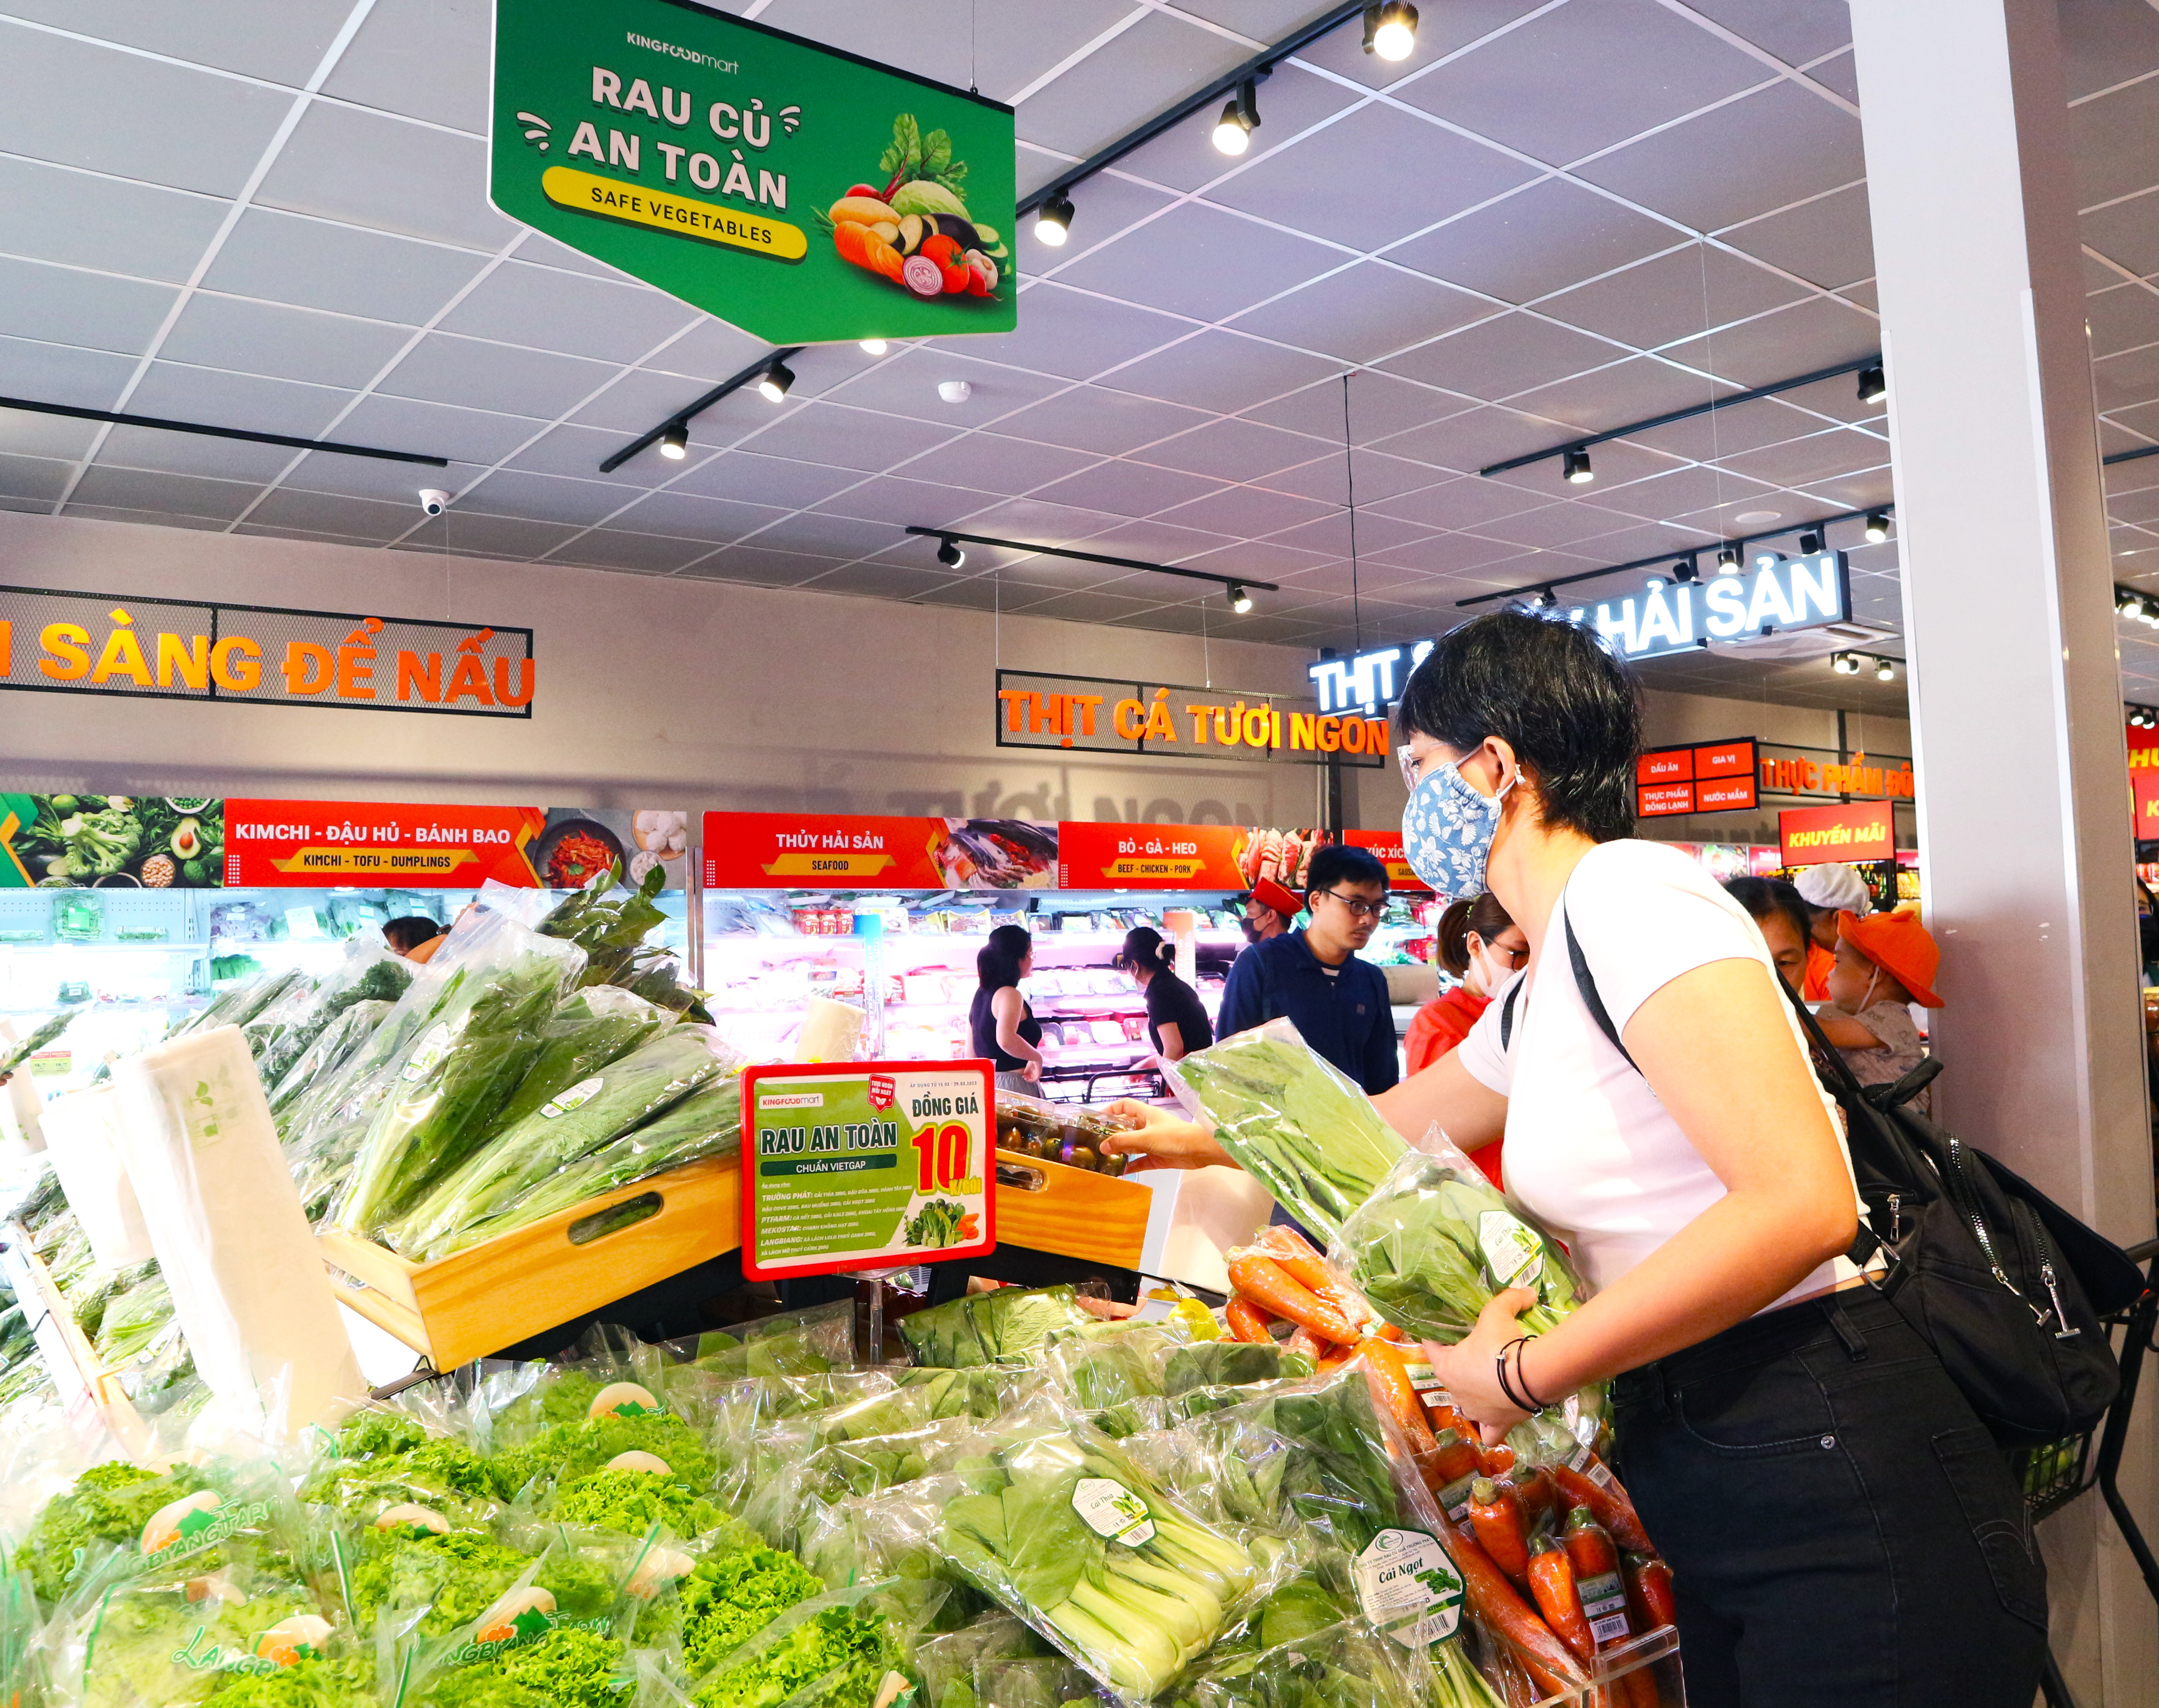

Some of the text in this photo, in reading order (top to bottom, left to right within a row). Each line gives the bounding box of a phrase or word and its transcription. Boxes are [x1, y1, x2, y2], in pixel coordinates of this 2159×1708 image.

[593, 66, 770, 147] RAU CỦ
[567, 121, 787, 209] AN TOÀN
[592, 187, 772, 244] SAFE VEGETABLES
[1706, 556, 1837, 637] SẢN
[39, 607, 261, 691] SÀNG
[281, 618, 377, 699] ĐỂ
[395, 627, 535, 707] NẤU
[1309, 648, 1400, 714] THỊT
[998, 686, 1389, 755] THỊT CÁ TƯƠI NGON
[1712, 754, 1735, 764] GIA VỊ
[1759, 756, 1818, 796] THỰC
[1644, 792, 1665, 801] THỰC
[1668, 801, 1688, 811] LẠNH
[1703, 792, 1726, 802] NƯỚC
[236, 824, 310, 840] KIMCHI
[326, 820, 367, 845] ĐẬU
[373, 821, 399, 842] HỦ
[416, 823, 467, 843] BÁNH
[473, 829, 511, 844] BAO
[776, 829, 883, 849] THỦY HẢI SẢN
[1789, 822, 1886, 848] KHUYẾN MÃI
[1119, 837, 1136, 854] BÒ
[1145, 838, 1163, 854] GÀ
[1172, 842, 1197, 854] HEO
[303, 855, 342, 866] KIMCHI
[353, 855, 380, 867] TOFU
[391, 855, 451, 867] DUMPLINGS
[812, 860, 849, 870] SEAFOOD
[1118, 864, 1134, 873] BEEF
[1141, 864, 1168, 873] CHICKEN
[1174, 865, 1191, 873] PORK
[912, 1091, 979, 1117] ĐỒNG GIÁ
[761, 1117, 898, 1155] RAU AN TOÀN
[796, 1159, 865, 1173] CHUẨN VIETGAP
[911, 1122, 970, 1194] 10
[762, 1192, 791, 1201] TRƯỜNG
[950, 1176, 982, 1196] K/GÓI
[761, 1215, 792, 1223] PTFARM:
[761, 1237, 803, 1246] LANGBIANG:
[1379, 1567, 1396, 1583] Cải
[1398, 1557, 1424, 1576] Ngọt
